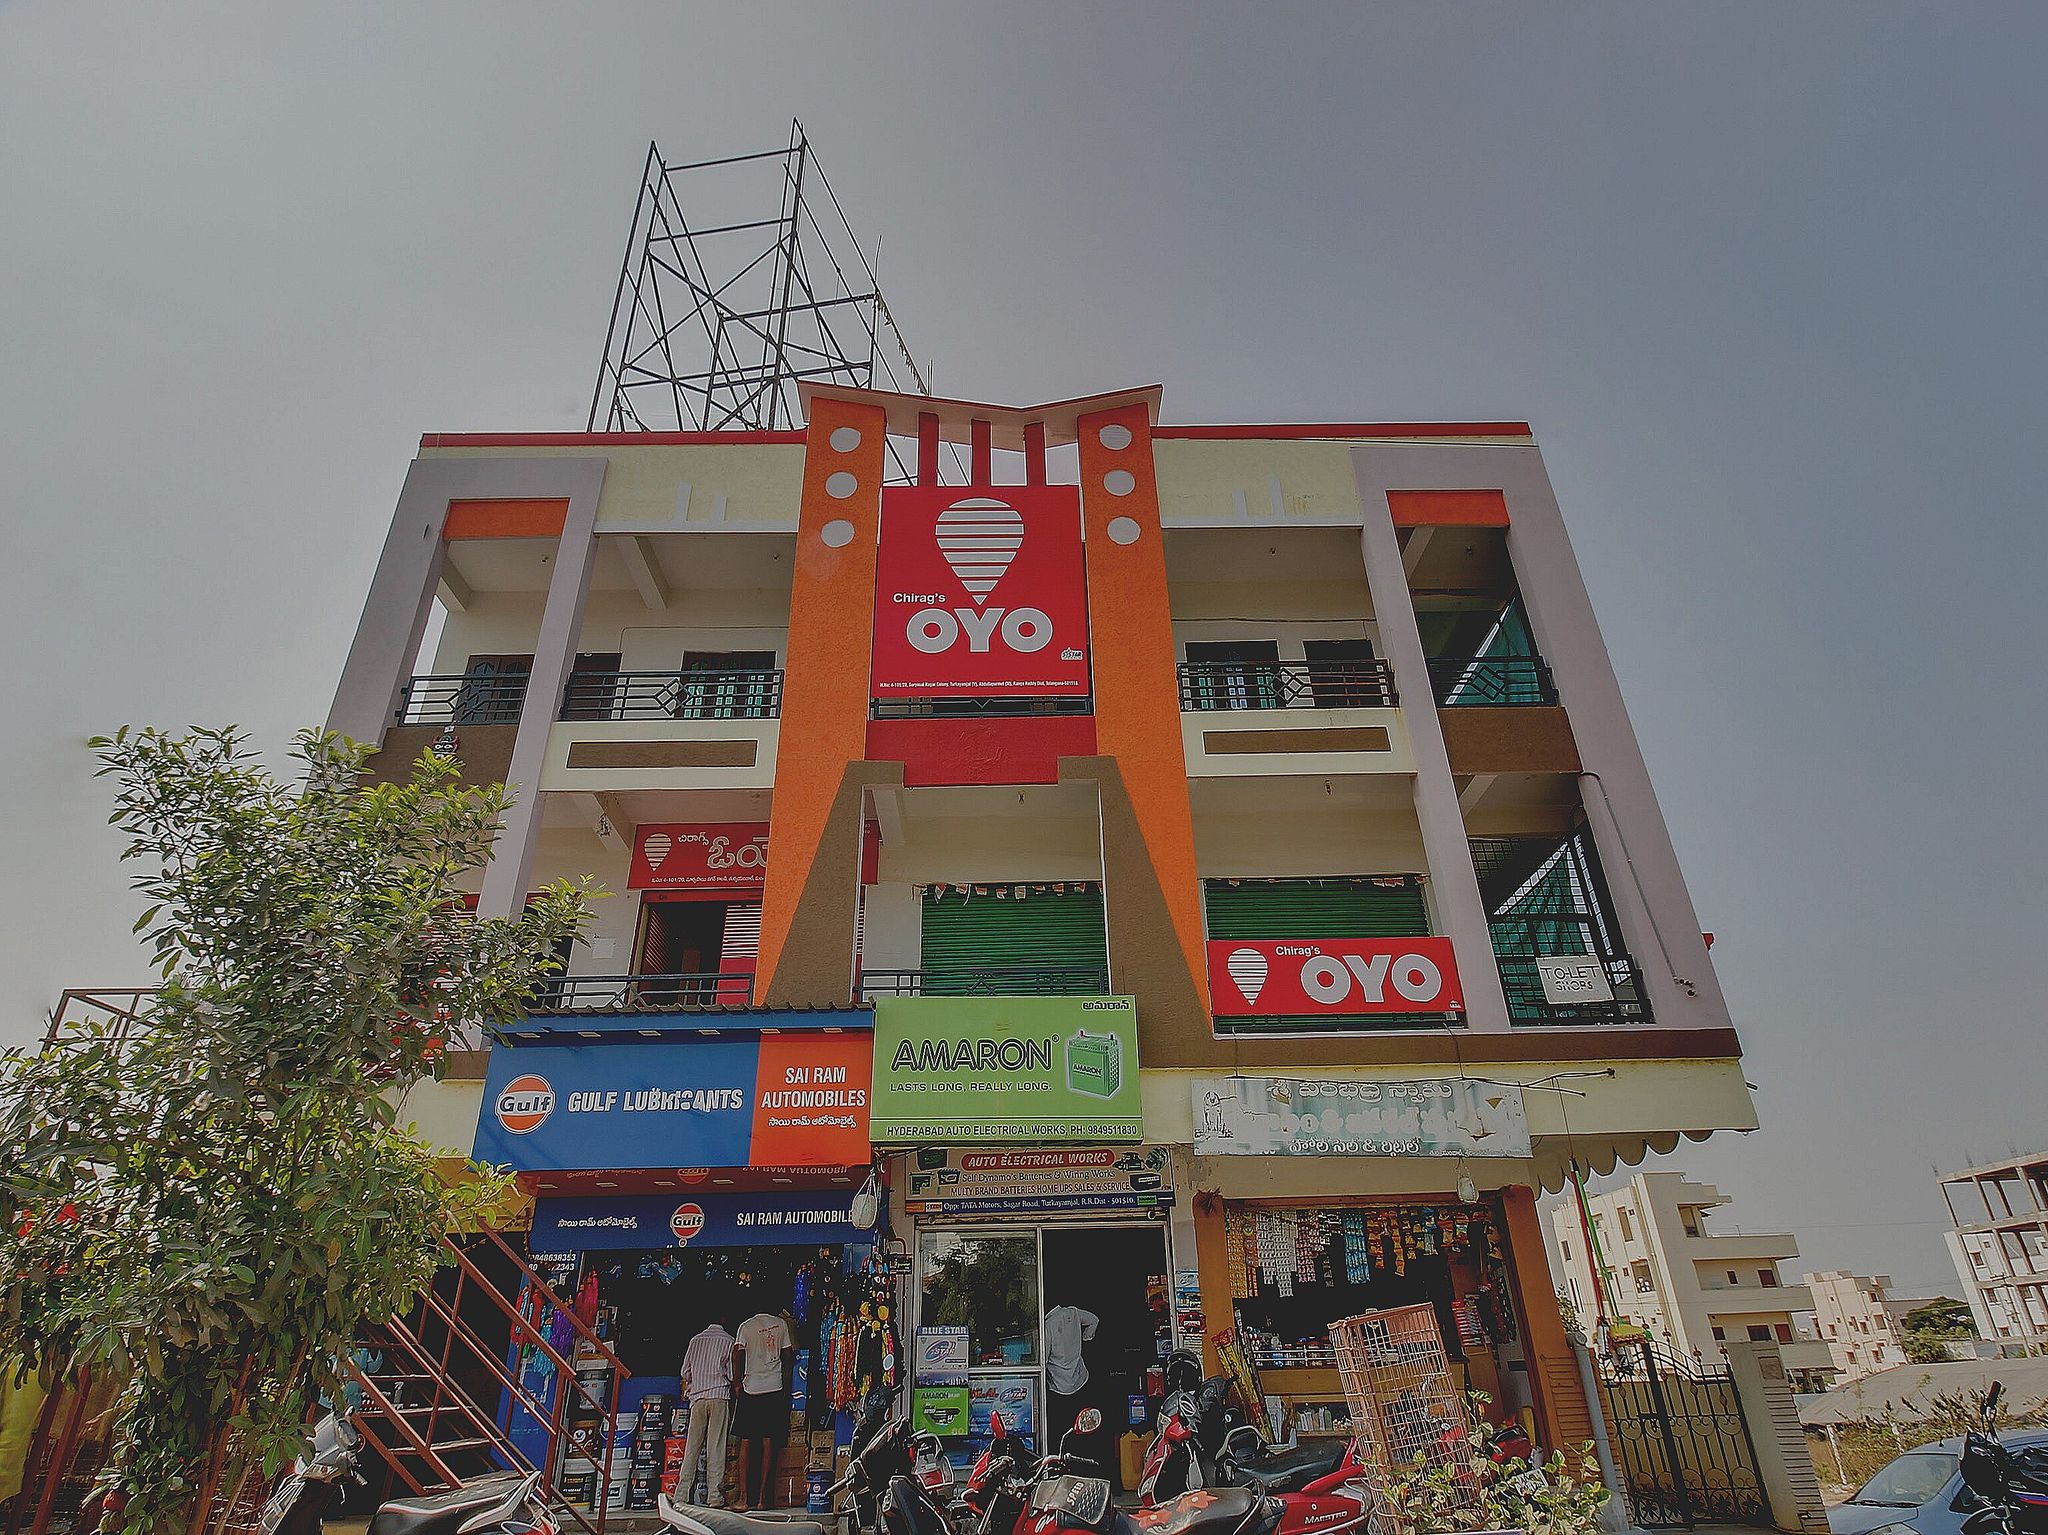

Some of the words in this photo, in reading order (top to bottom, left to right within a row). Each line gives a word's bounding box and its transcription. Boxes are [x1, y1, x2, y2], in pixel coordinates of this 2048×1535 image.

[893, 593, 946, 604] Chirag's
[906, 607, 1053, 654] OYO
[1275, 945, 1321, 956] Chirag's
[1300, 953, 1442, 1004] OYO
[1540, 965, 1600, 980] TO-LET
[890, 1038, 1052, 1072] AMARON
[785, 1067, 809, 1084] SAI
[813, 1066, 846, 1083] RAM
[890, 1083, 927, 1093] LASTS
[931, 1083, 967, 1093] LONG,
[970, 1082, 1013, 1091] REALLY
[1017, 1082, 1052, 1091] LONG.
[500, 1096, 551, 1112] Gulf
[568, 1091, 617, 1112] GULF
[761, 1089, 866, 1108] AUTOMOBILES
[887, 1126, 944, 1136] HYDERABAD
[945, 1126, 970, 1136] AUTO
[973, 1126, 1030, 1136] ELECTRICAL
[1031, 1125, 1068, 1136] WORKS,
[1070, 1125, 1086, 1135] PH:
[1087, 1125, 1137, 1135] 9849511830
[1362, 1138, 1377, 1153] &
[968, 1156, 997, 1167] AUTO
[1001, 1153, 1064, 1166] ELECTRICAL
[1068, 1152, 1107, 1164] WORKS
[962, 1173, 977, 1183] Self
[978, 1172, 1017, 1183] Dynamo's
[1018, 1171, 1052, 1181] Batteries
[1053, 1170, 1061, 1179] &
[1092, 1169, 1116, 1178] Works
[975, 1186, 998, 1195] BRAND
[1000, 1185, 1036, 1195] BATTERIES
[1037, 1184, 1058, 1194] HOME
[1060, 1183, 1073, 1193] UPS
[1074, 1183, 1094, 1192] SALES
[1096, 1182, 1103, 1191] &
[1103, 1181, 1130, 1191] SERVICE
[960, 1201, 977, 1209] TATA
[672, 1215, 702, 1226] Gulf
[736, 1213, 755, 1226] SAI
[757, 1212, 782, 1225] RAM
[785, 1210, 853, 1224] AUTOMOBILE
[922, 1327, 943, 1335] BLUE
[944, 1326, 966, 1334] STAR
